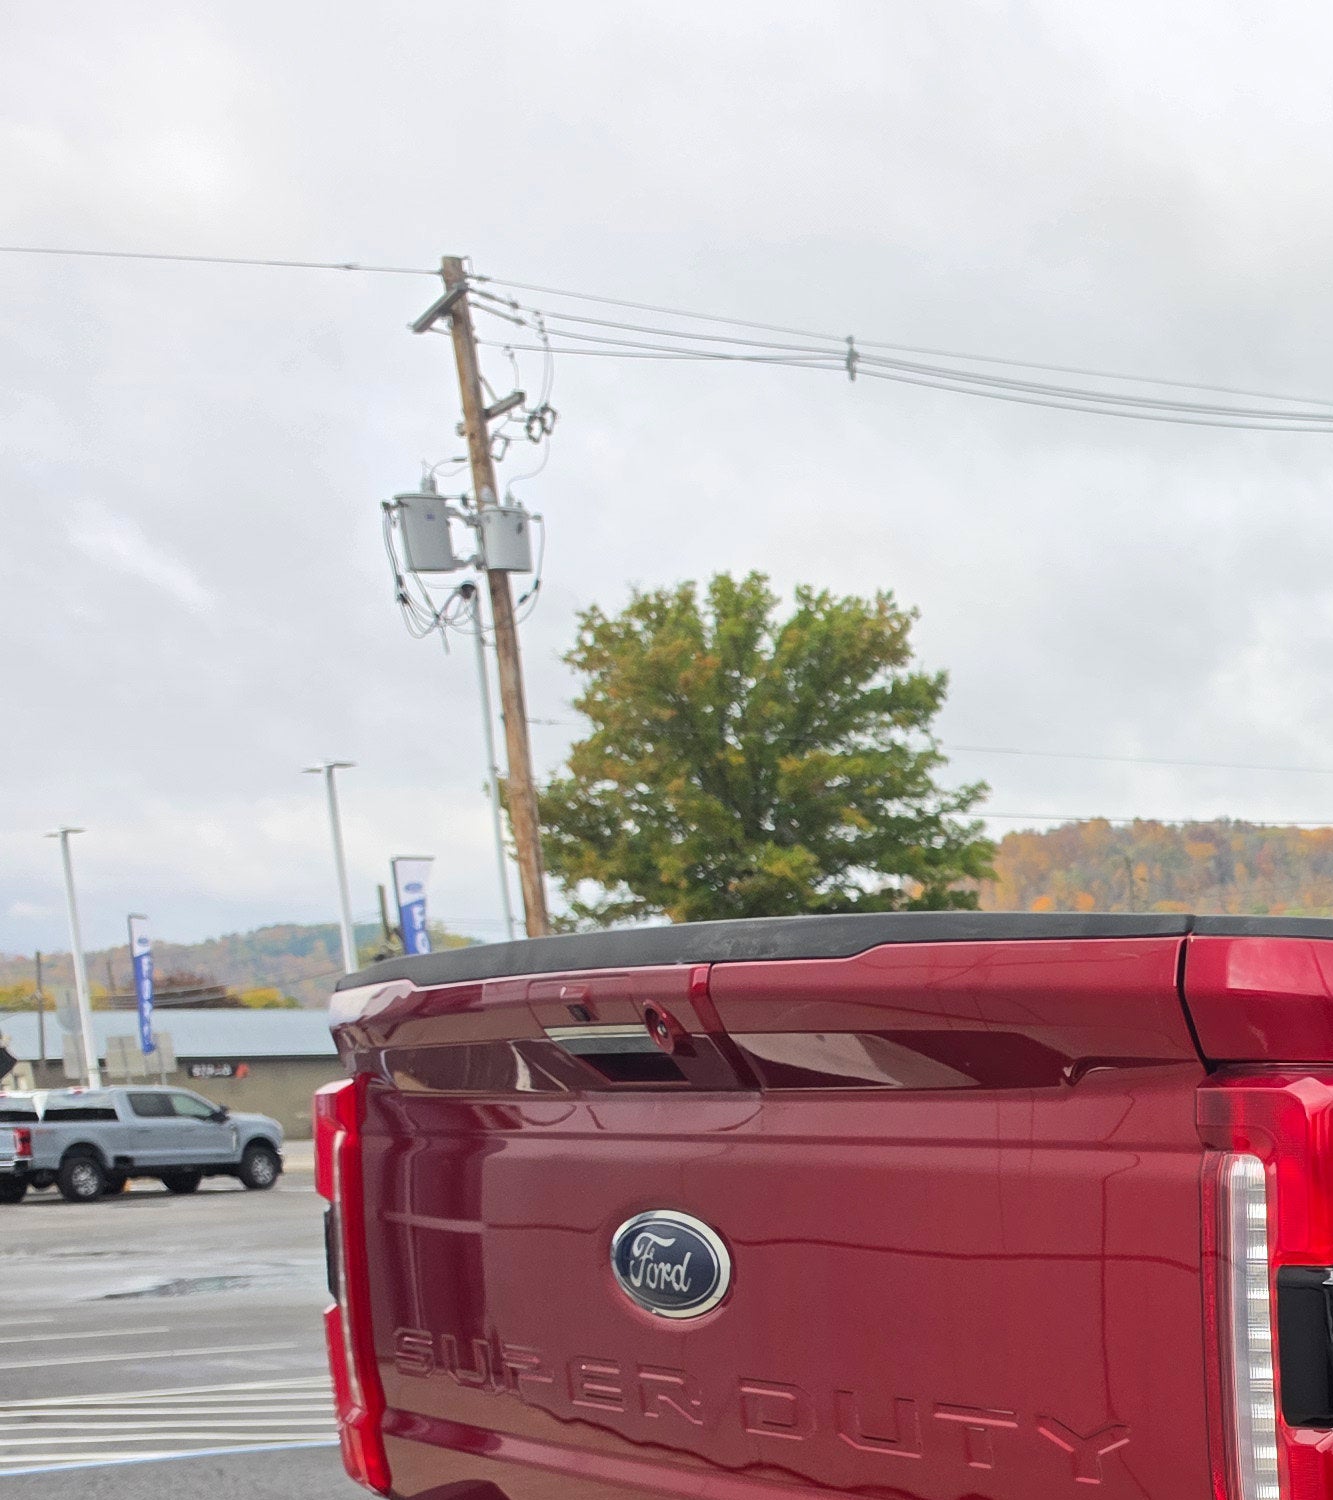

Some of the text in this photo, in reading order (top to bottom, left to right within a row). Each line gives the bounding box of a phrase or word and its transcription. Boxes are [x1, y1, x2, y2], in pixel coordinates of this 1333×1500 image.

[630, 1231, 692, 1292] Ford
[393, 1327, 1131, 1485] SUPER DUTY
